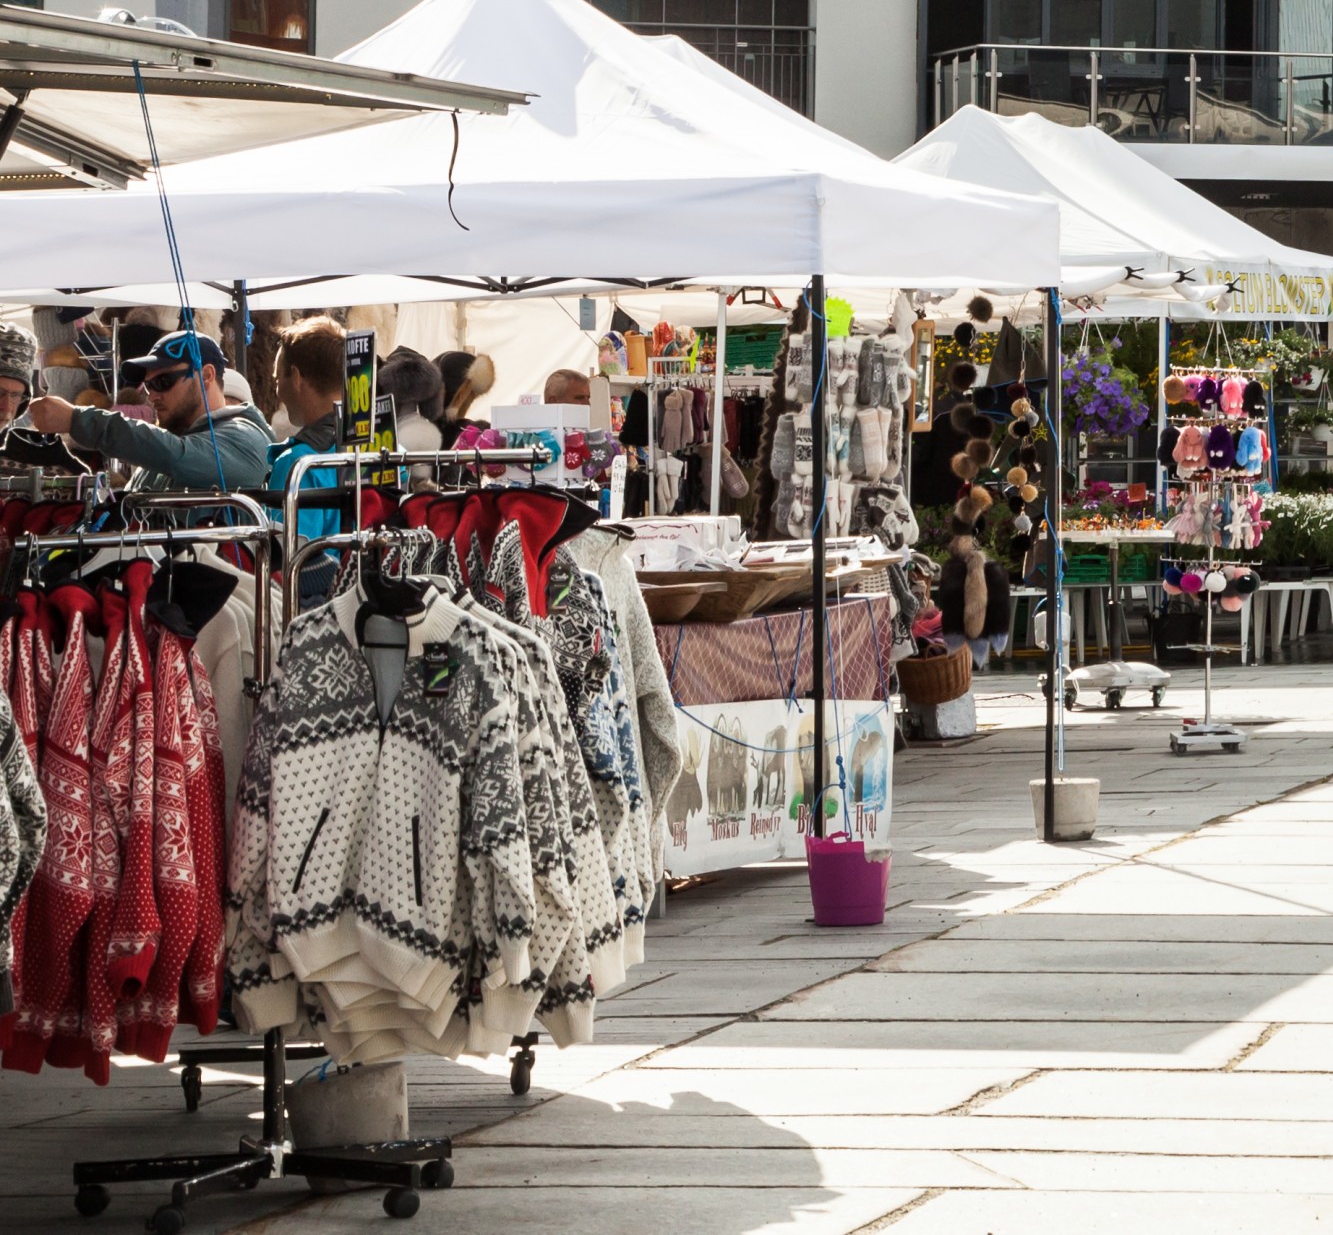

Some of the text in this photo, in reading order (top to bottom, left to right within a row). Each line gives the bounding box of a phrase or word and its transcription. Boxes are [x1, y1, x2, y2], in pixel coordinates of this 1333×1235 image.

[672, 821, 688, 852] Elg
[710, 817, 740, 842] Moskus
[855, 804, 883, 839] Hval
